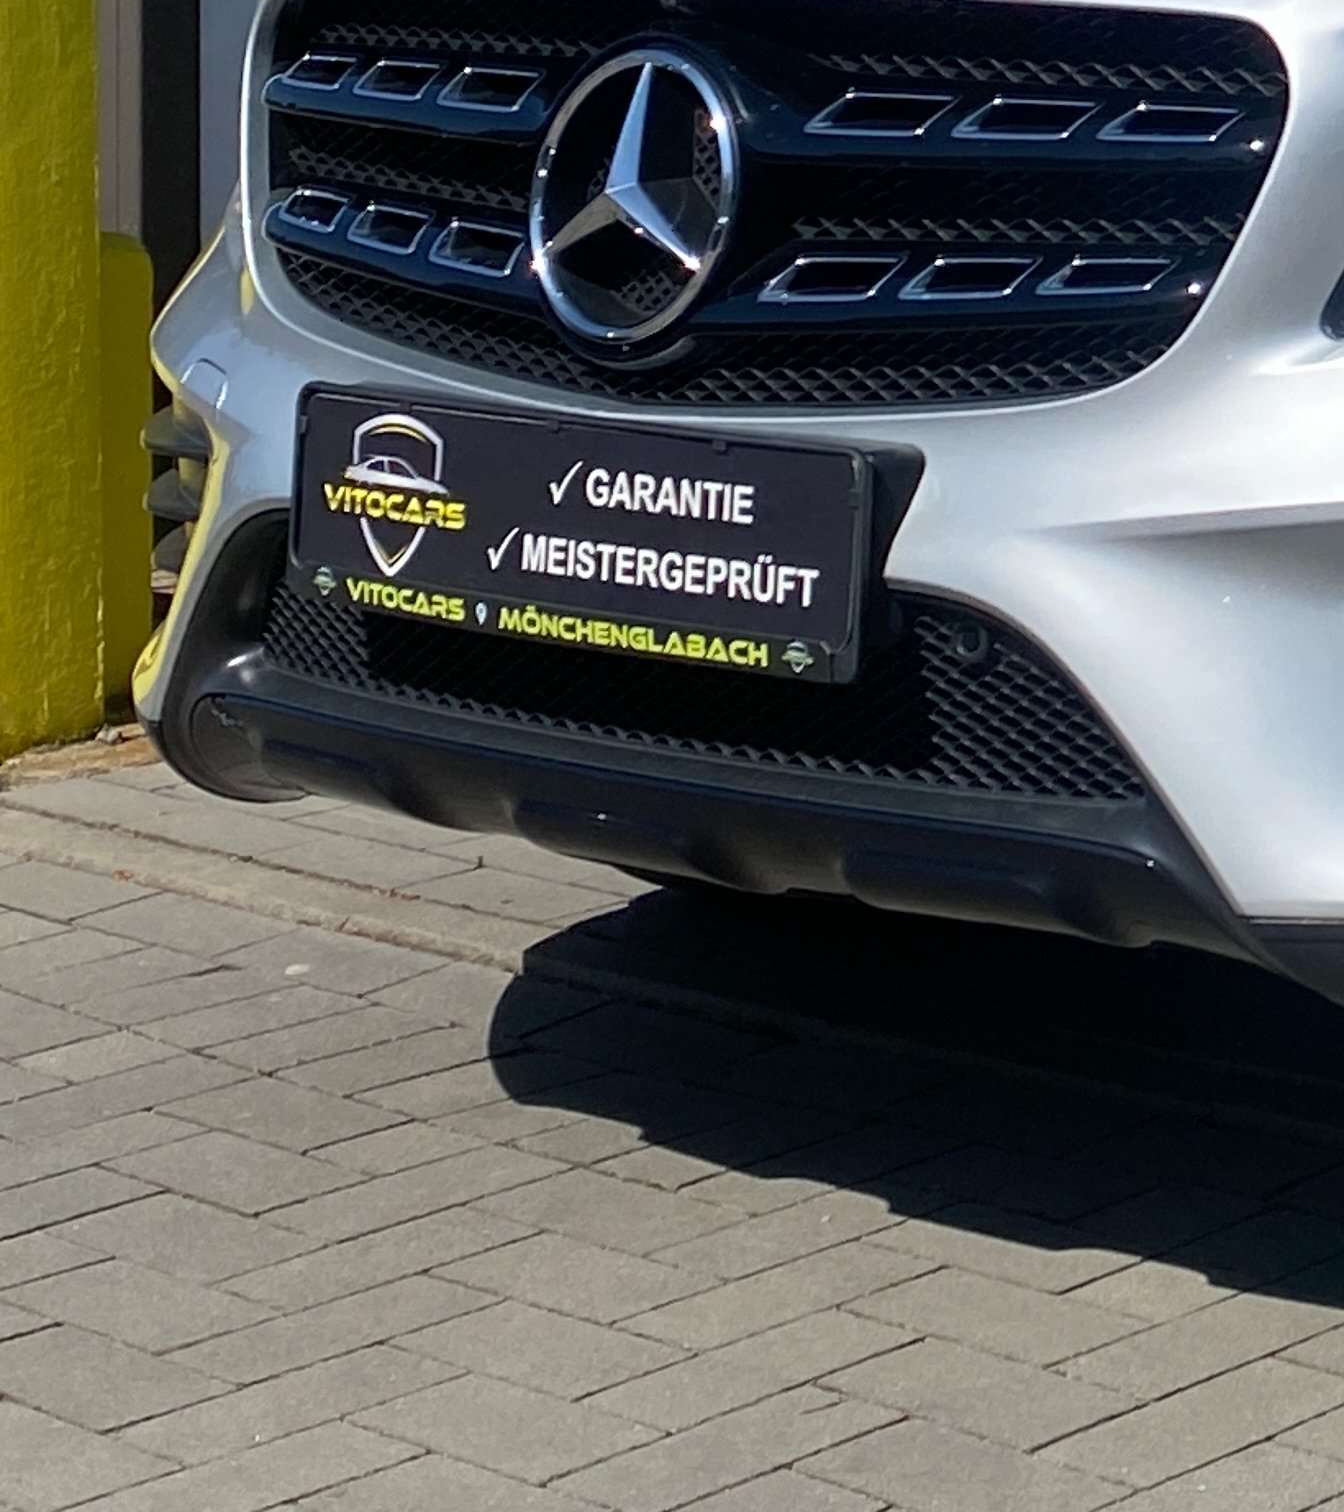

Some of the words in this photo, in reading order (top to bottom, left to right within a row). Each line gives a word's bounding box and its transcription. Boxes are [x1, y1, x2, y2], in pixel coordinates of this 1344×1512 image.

[323, 481, 468, 531] VITOCARS
[586, 466, 755, 525] GARANTIE
[521, 532, 820, 608] MEISTERGEPRÜFT
[346, 576, 466, 623] VITOCARS
[498, 604, 770, 668] MÖNCHENGLABACH
